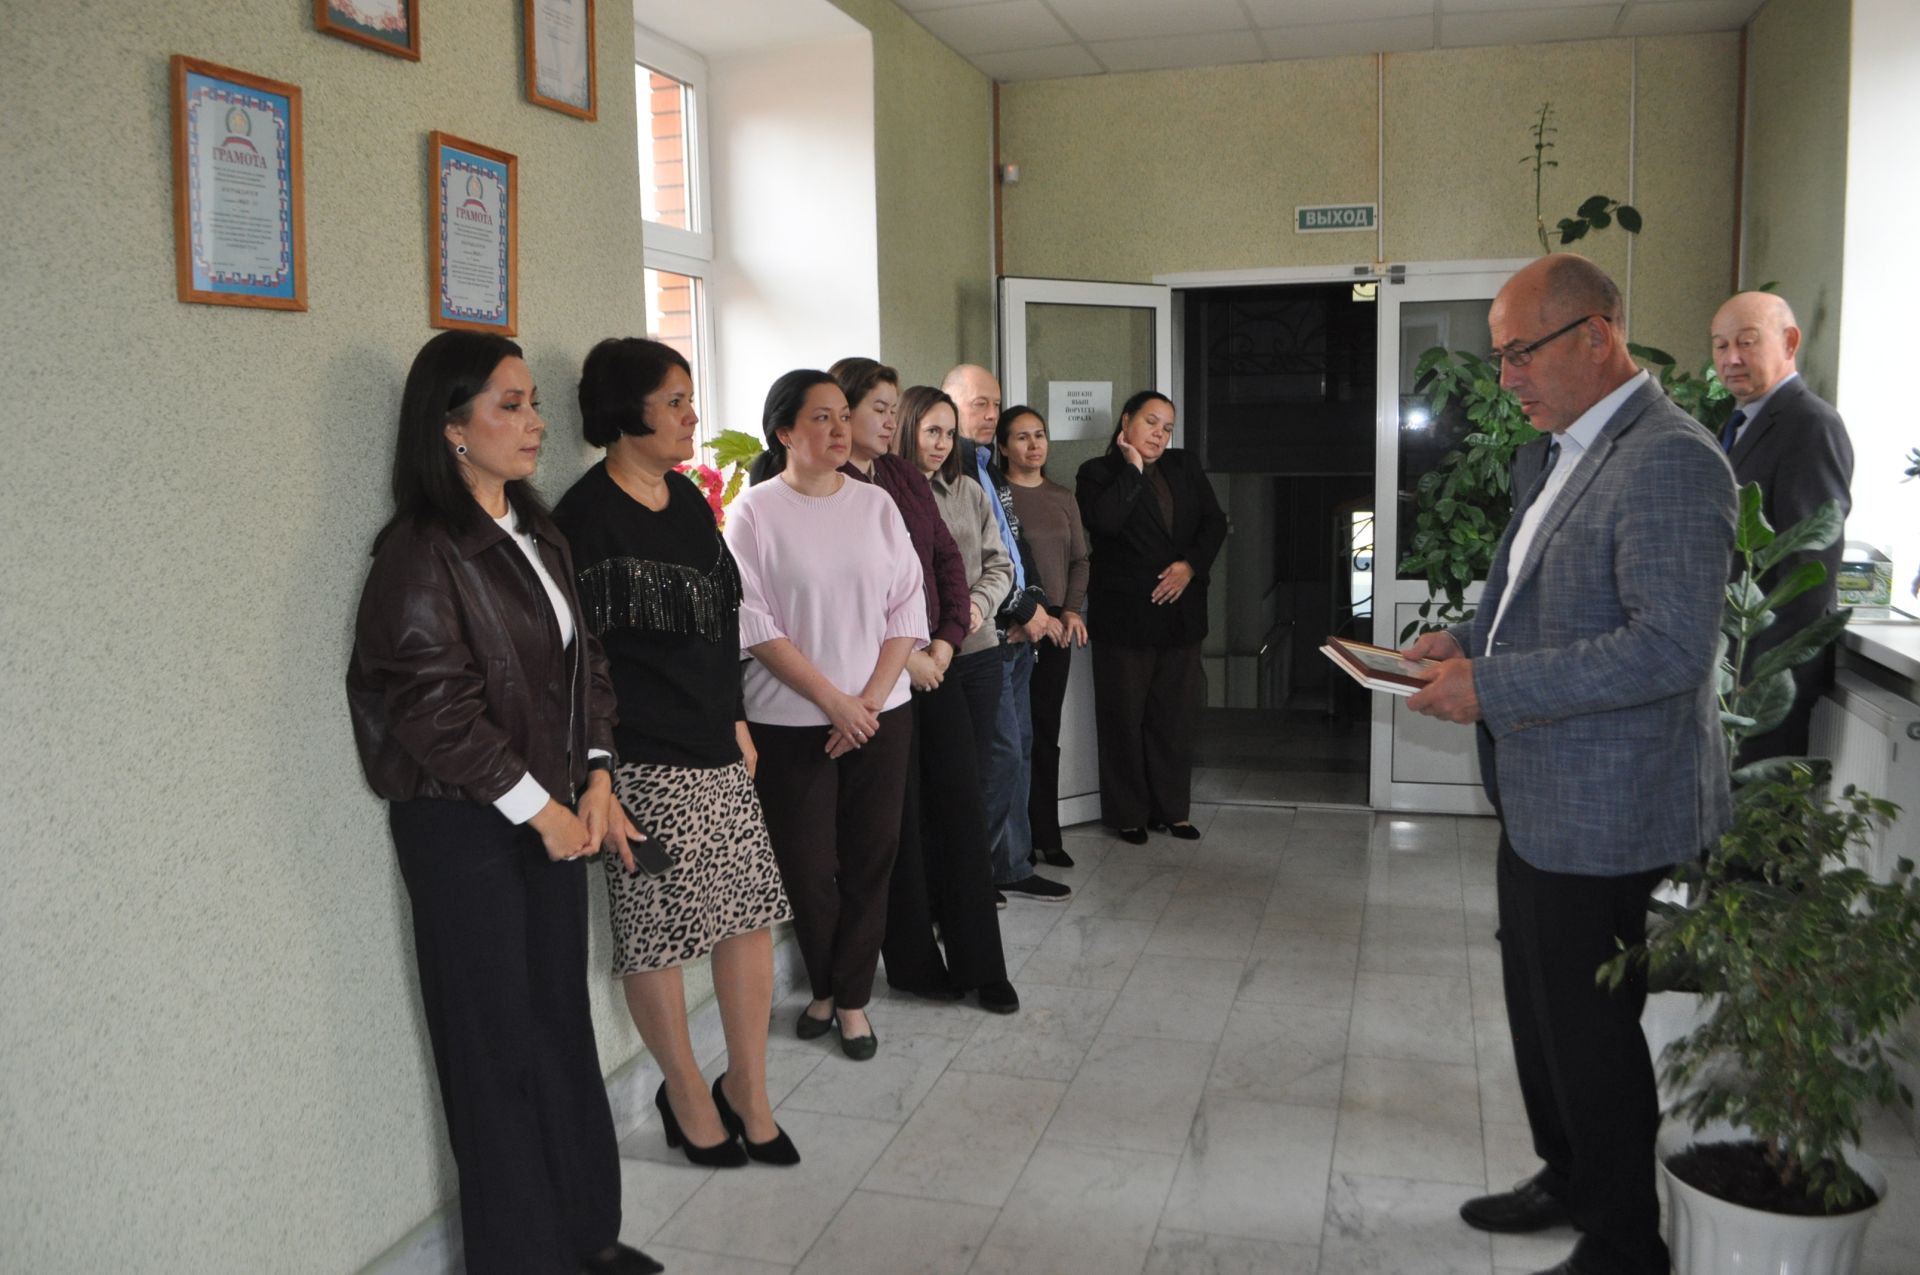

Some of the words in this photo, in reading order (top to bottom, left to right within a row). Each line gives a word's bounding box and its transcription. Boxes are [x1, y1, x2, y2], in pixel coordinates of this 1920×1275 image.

[212, 147, 268, 169] ГРАМОТА
[456, 206, 493, 225] ГРАМОТА
[1305, 209, 1368, 226] ВЫХОД
